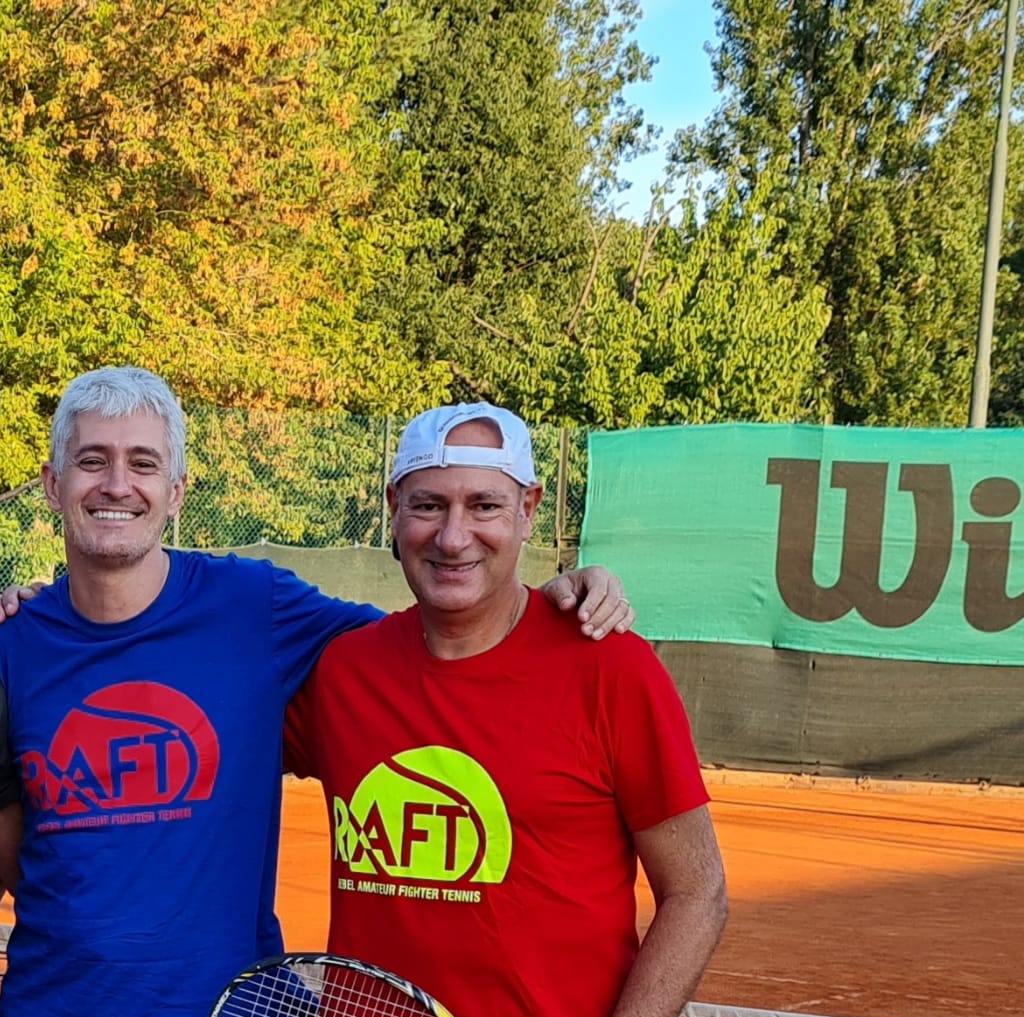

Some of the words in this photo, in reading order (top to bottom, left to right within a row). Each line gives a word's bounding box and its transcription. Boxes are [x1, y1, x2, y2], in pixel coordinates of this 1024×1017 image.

[20, 731, 180, 811] RAFT
[333, 795, 471, 872] RAFT
[357, 880, 396, 896] AMATEUR
[398, 884, 439, 901] FIGHTER
[441, 888, 482, 903] TENNIS
